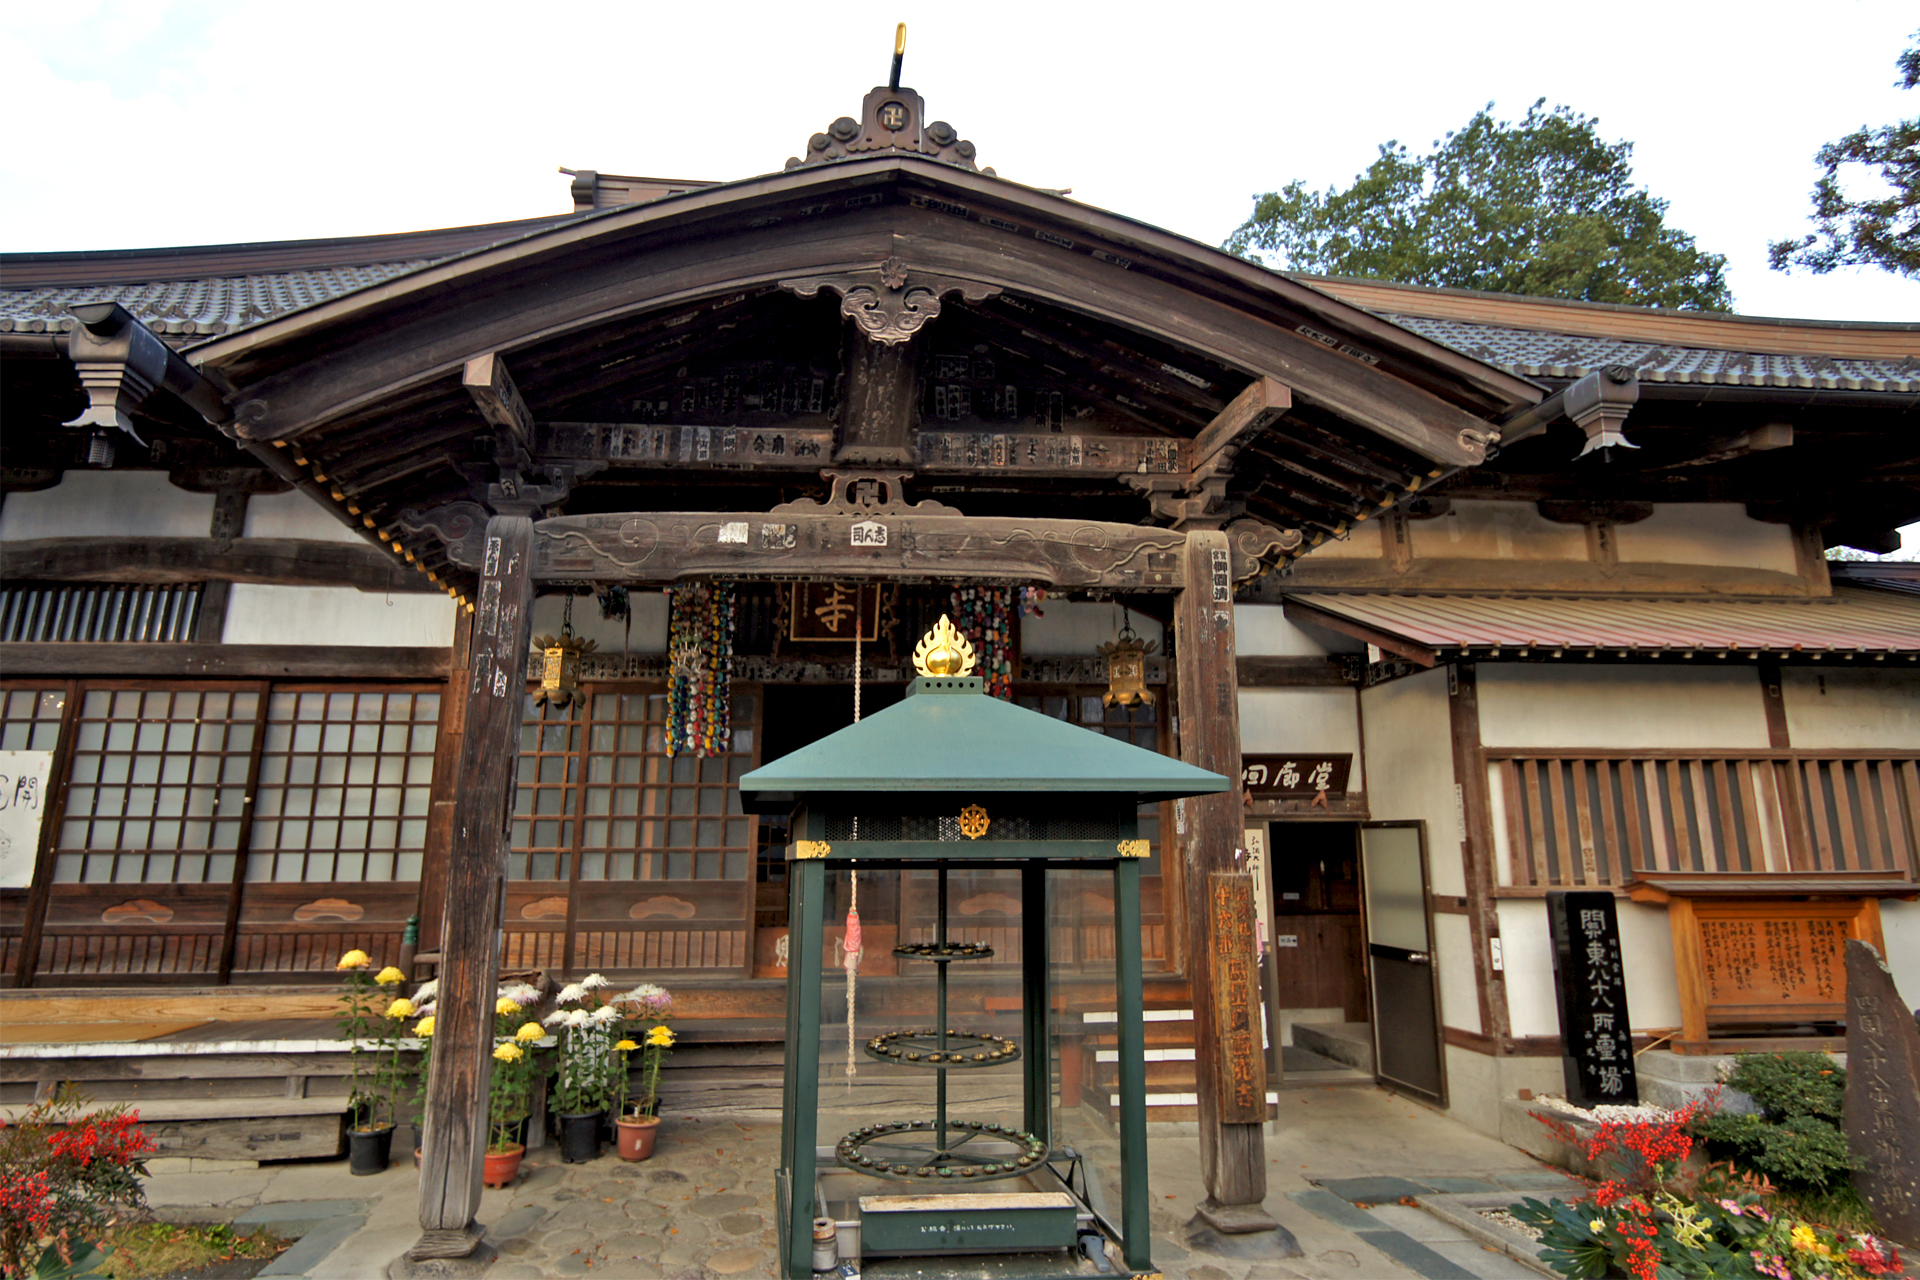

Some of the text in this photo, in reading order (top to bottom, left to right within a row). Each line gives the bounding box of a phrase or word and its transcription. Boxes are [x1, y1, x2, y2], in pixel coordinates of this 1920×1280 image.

[814, 583, 856, 633] 寺
[1242, 760, 1334, 790] 回廊堂
